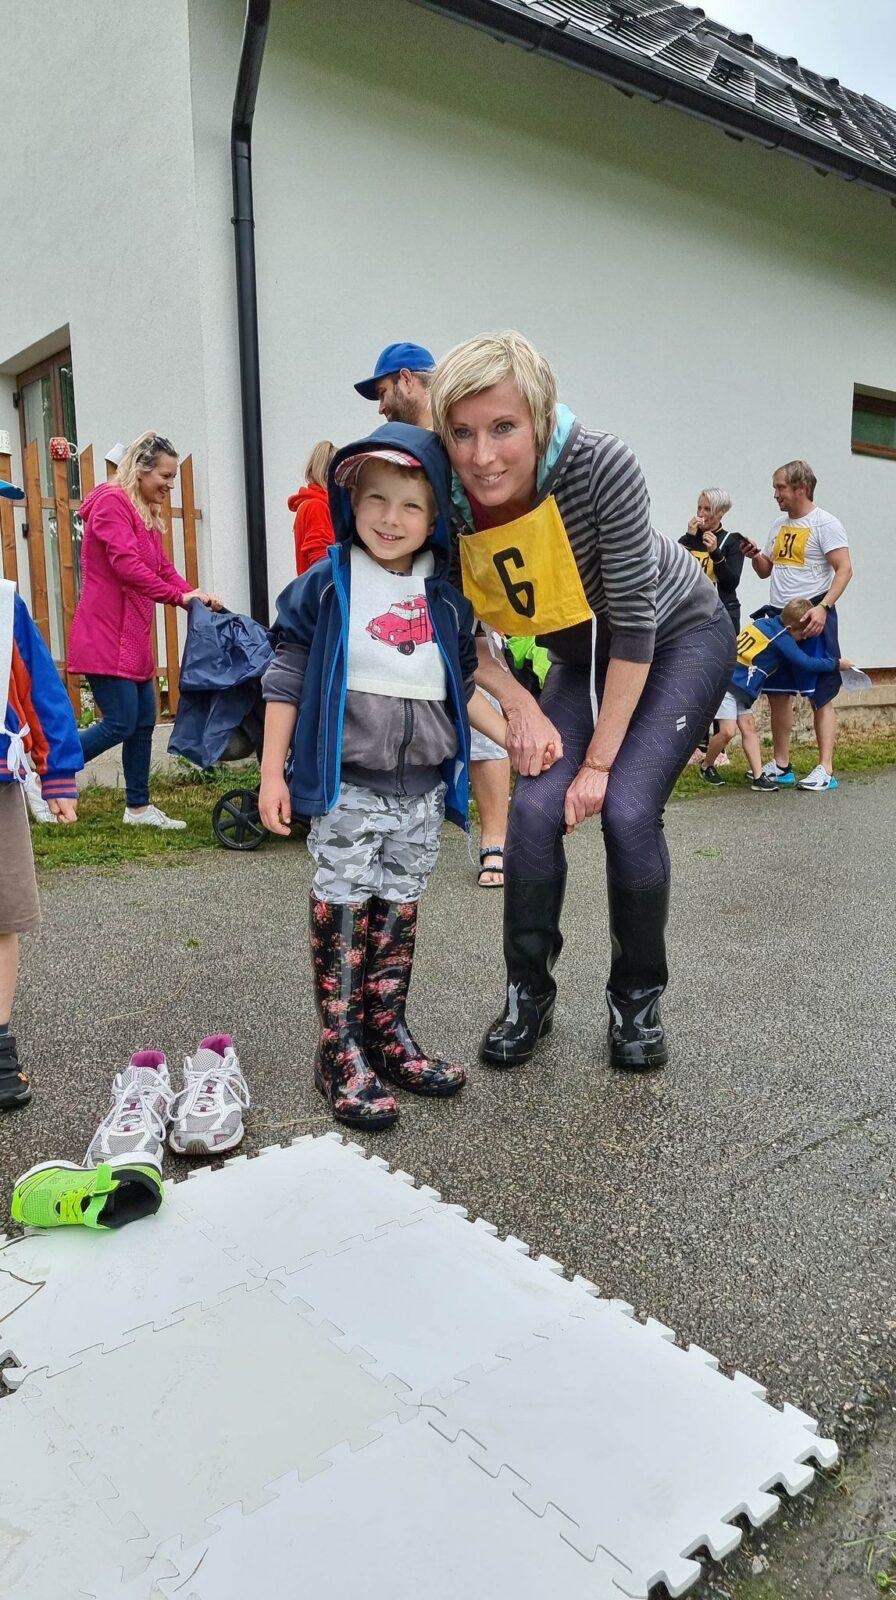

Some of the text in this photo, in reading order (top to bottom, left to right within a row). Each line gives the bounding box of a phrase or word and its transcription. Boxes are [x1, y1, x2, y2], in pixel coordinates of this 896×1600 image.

[779, 533, 797, 558] 31
[696, 556, 709, 574] 9
[493, 547, 535, 618] 6
